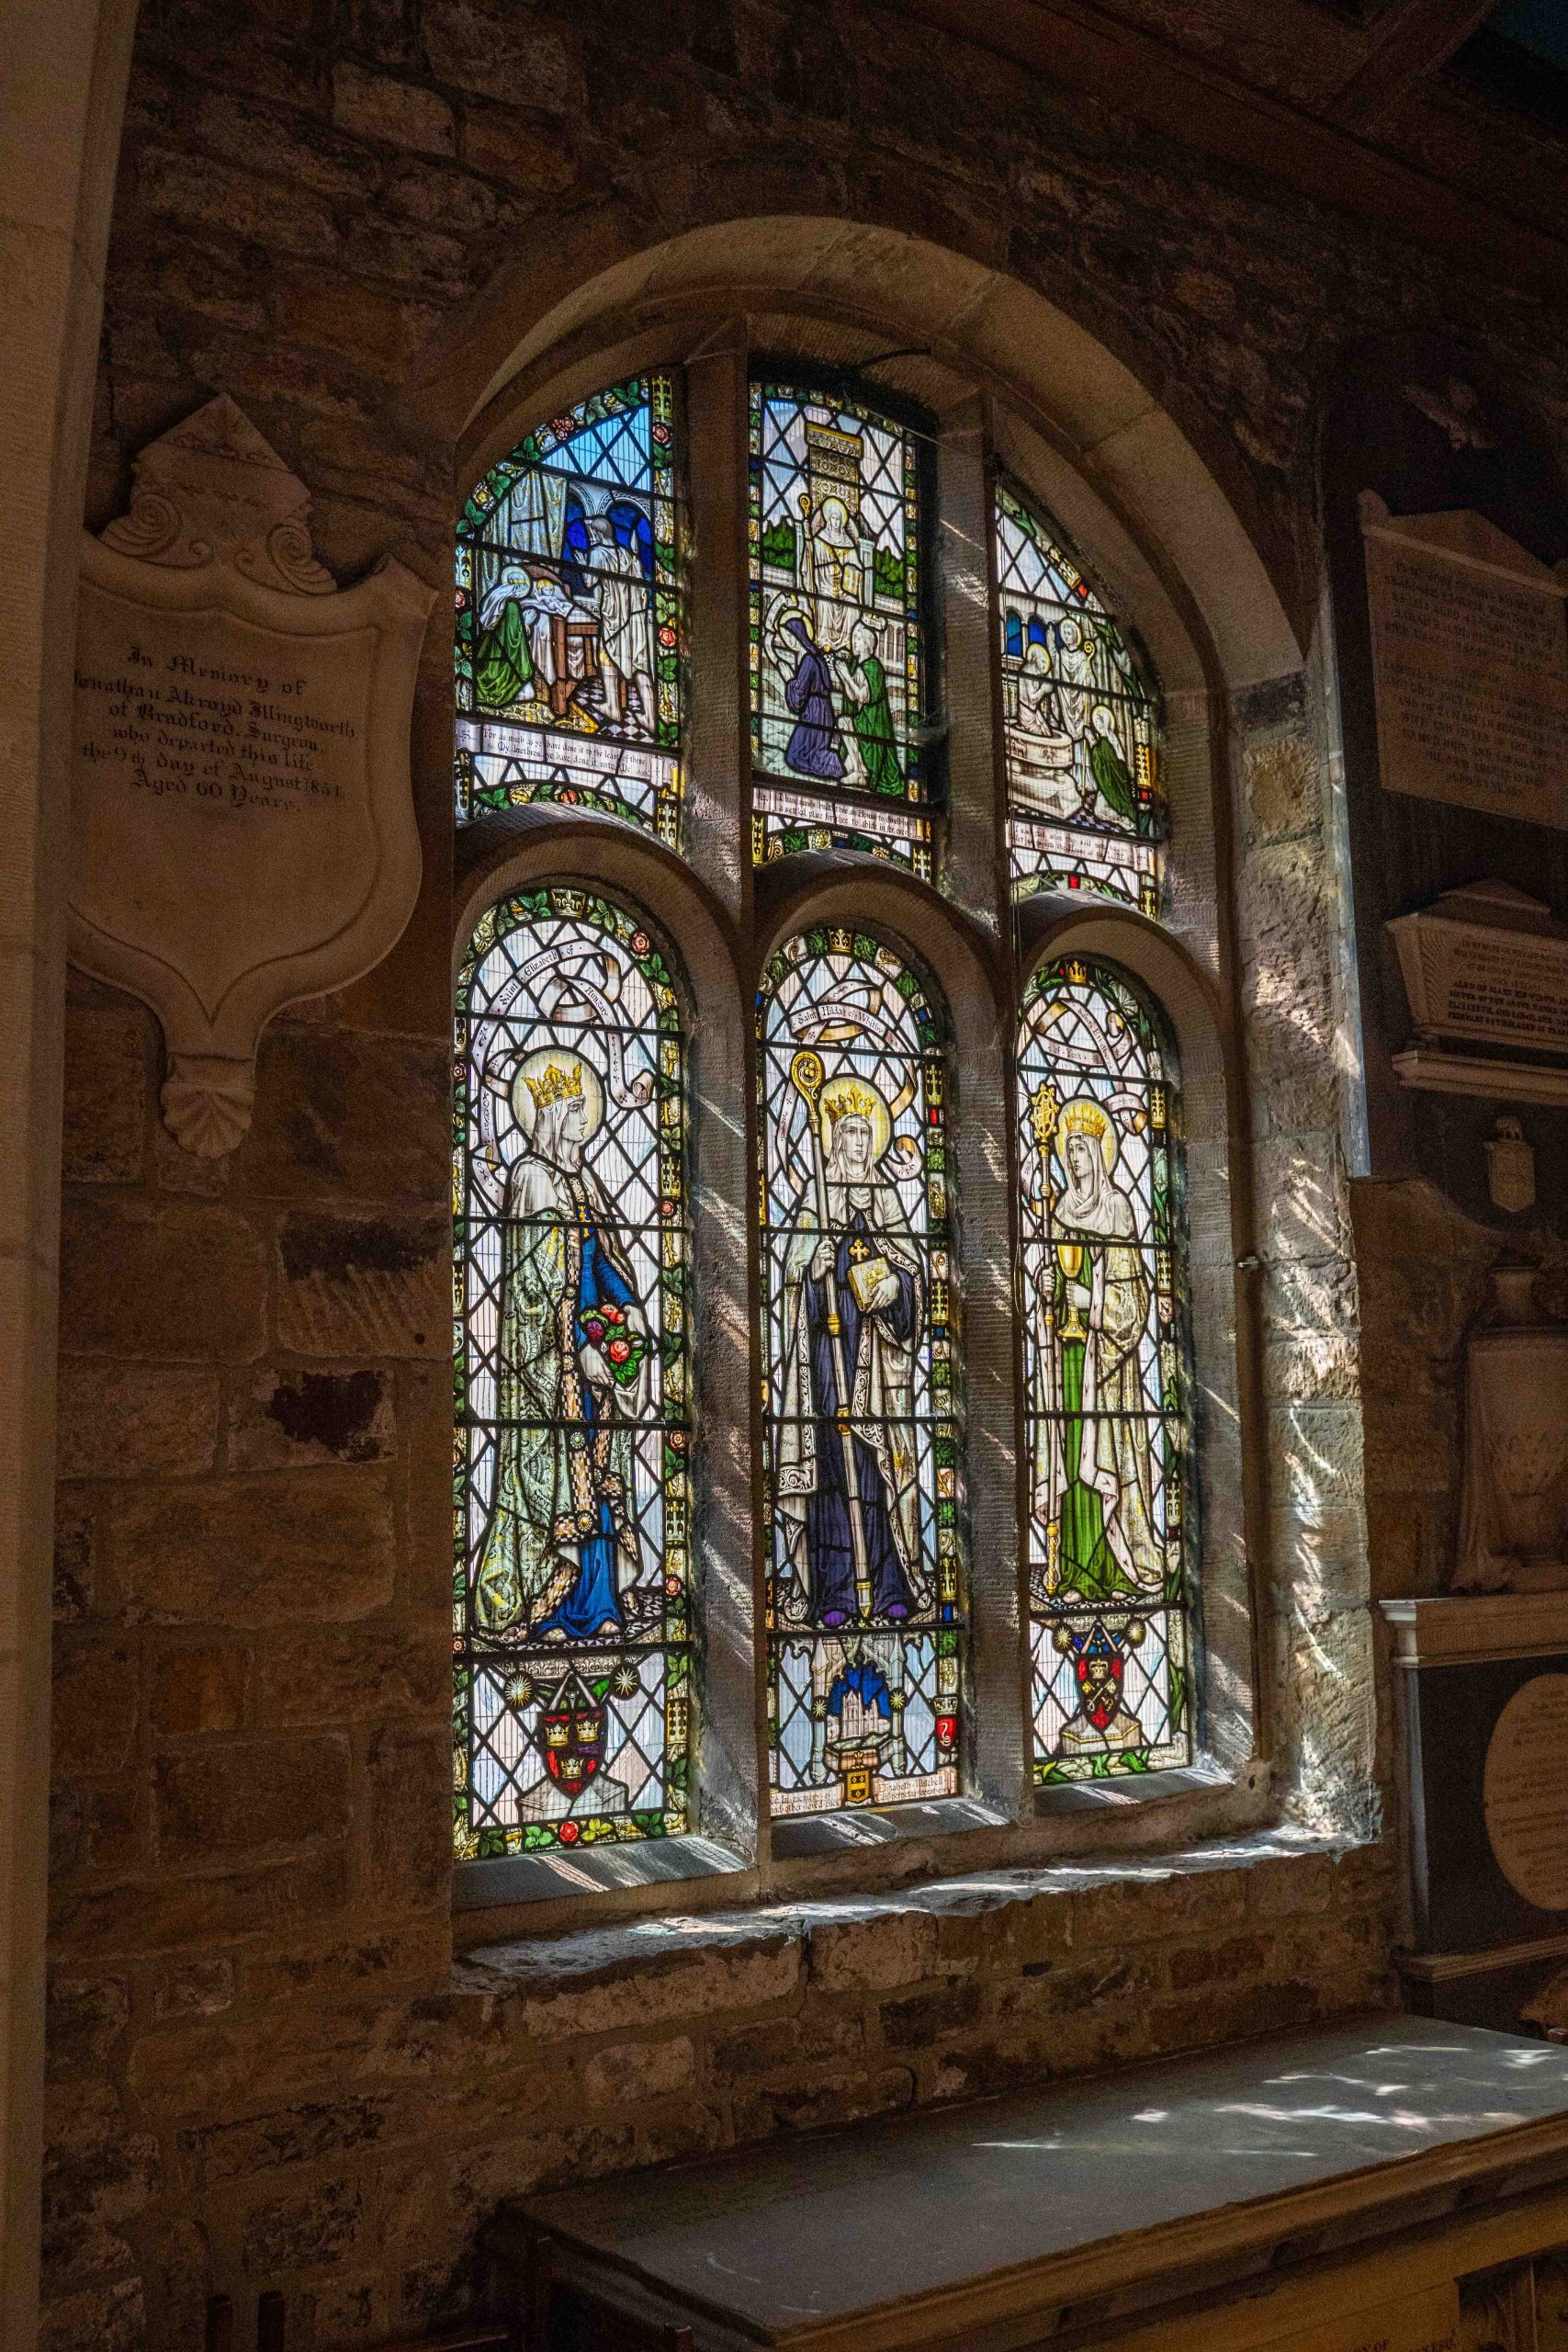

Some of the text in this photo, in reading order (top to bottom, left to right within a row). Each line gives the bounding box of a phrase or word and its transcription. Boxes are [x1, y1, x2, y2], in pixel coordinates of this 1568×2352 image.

[127, 646, 307, 696] In Memory of
[108, 702, 129, 718] of
[166, 685, 243, 718] Akroyd
[113, 725, 315, 772] who departed this life
[482, 728, 496, 739] For
[508, 734, 525, 744] much
[546, 740, 561, 750] have
[562, 742, 577, 753] done
[593, 749, 604, 757] the
[604, 750, 621, 761] least
[556, 752, 571, 763] have
[573, 755, 590, 766] done
[83, 741, 110, 763] the
[156, 751, 195, 777] day
[202, 761, 224, 776] of
[229, 763, 302, 791] August
[130, 768, 187, 797] Aged
[196, 780, 223, 798] 60
[785, 793, 798, 806] have
[858, 808, 877, 820] House
[878, 814, 885, 822] to
[886, 815, 901, 826] dwell
[808, 809, 824, 820] place
[861, 820, 877, 831] abide
[499, 944, 575, 1006] Saint Elizabeth of
[583, 986, 609, 1017] Hungary
[797, 1004, 883, 1034] Saint Hilda of Whitby
[1053, 1046, 1082, 1061] of York
